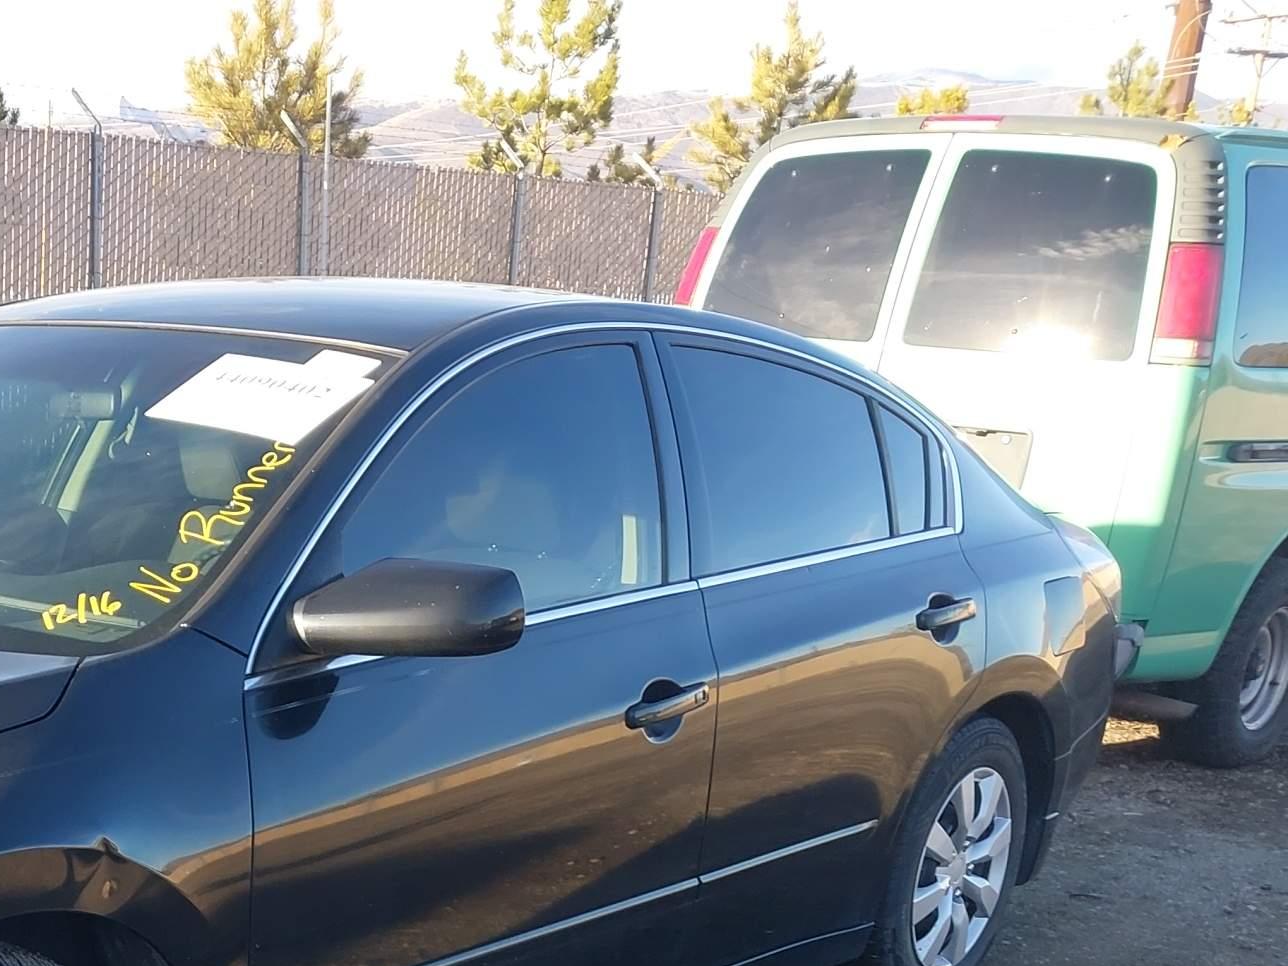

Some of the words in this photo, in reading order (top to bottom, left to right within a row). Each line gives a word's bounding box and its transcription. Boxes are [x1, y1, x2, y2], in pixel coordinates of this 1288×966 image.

[128, 562, 200, 604] No
[179, 441, 296, 546] Runner
[42, 590, 123, 631] 12/16
